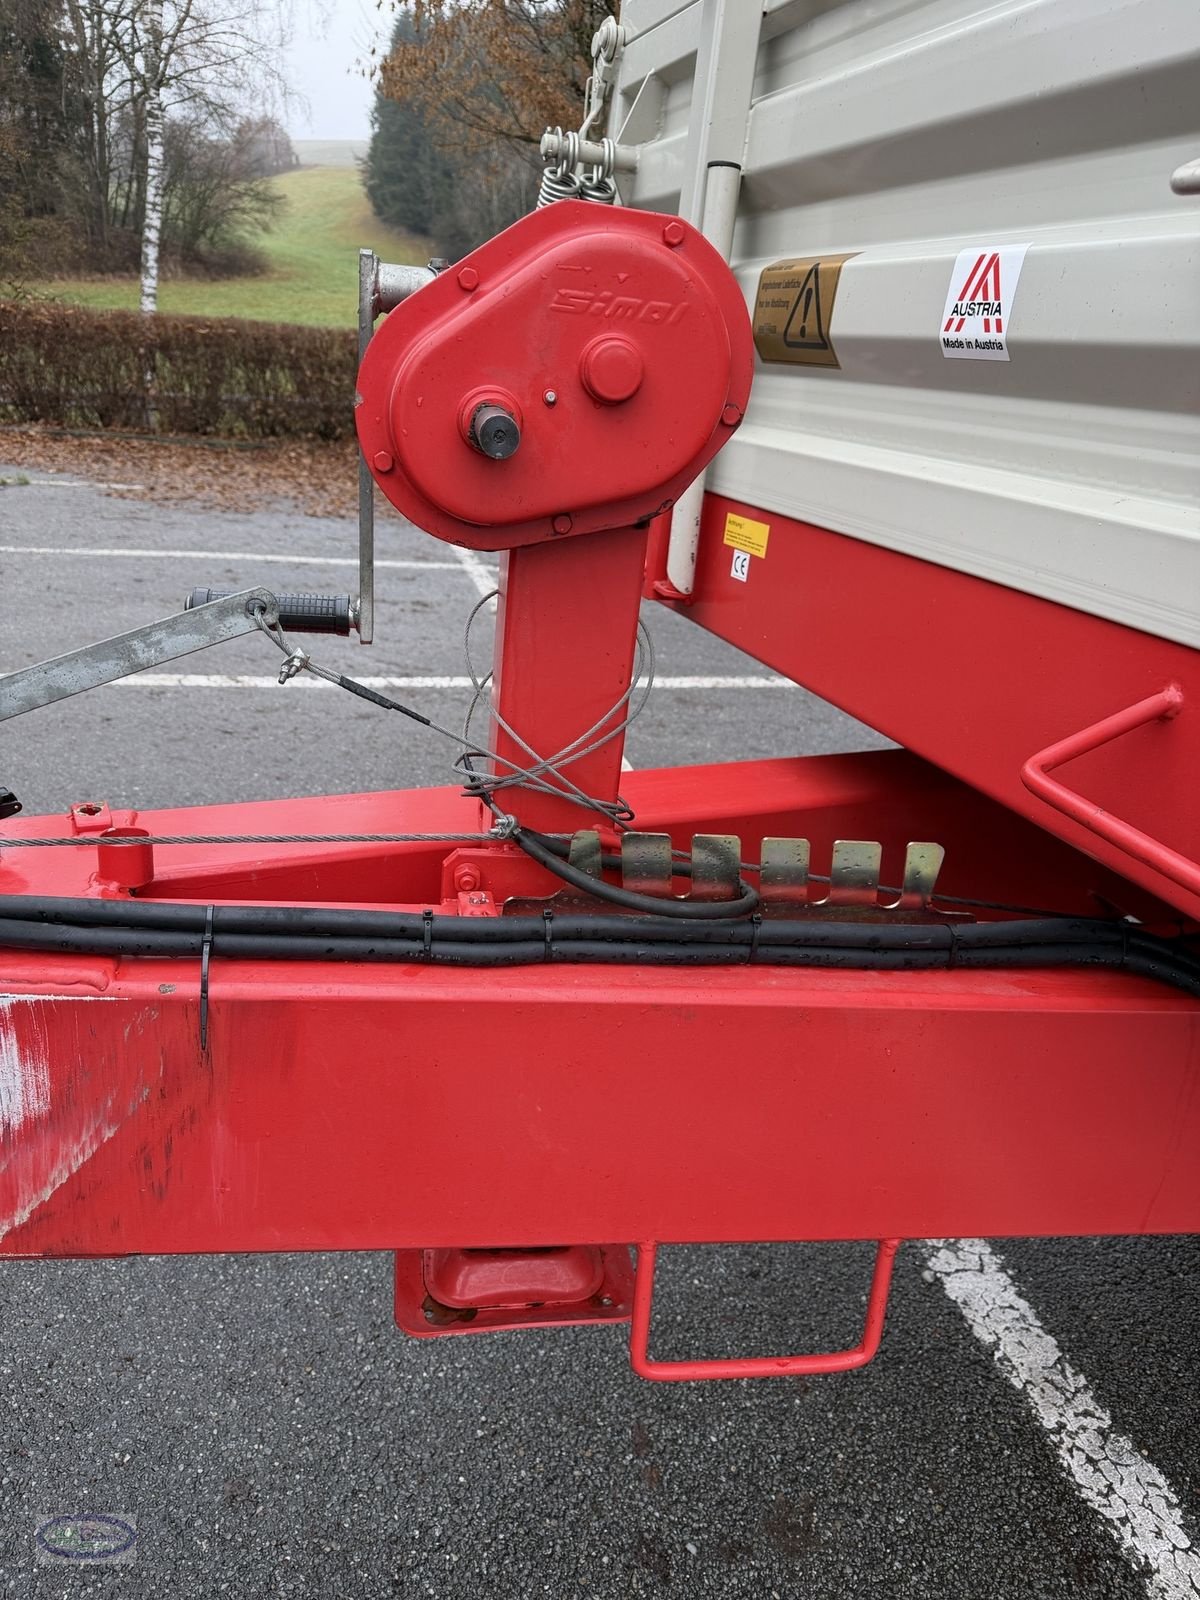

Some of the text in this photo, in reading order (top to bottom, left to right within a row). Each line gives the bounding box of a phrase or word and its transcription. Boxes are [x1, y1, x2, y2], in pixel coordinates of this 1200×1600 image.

[951, 302, 1002, 316] AUSTRIA
[943, 337, 1003, 350] Made in Austria
[734, 555, 747, 576] CE
